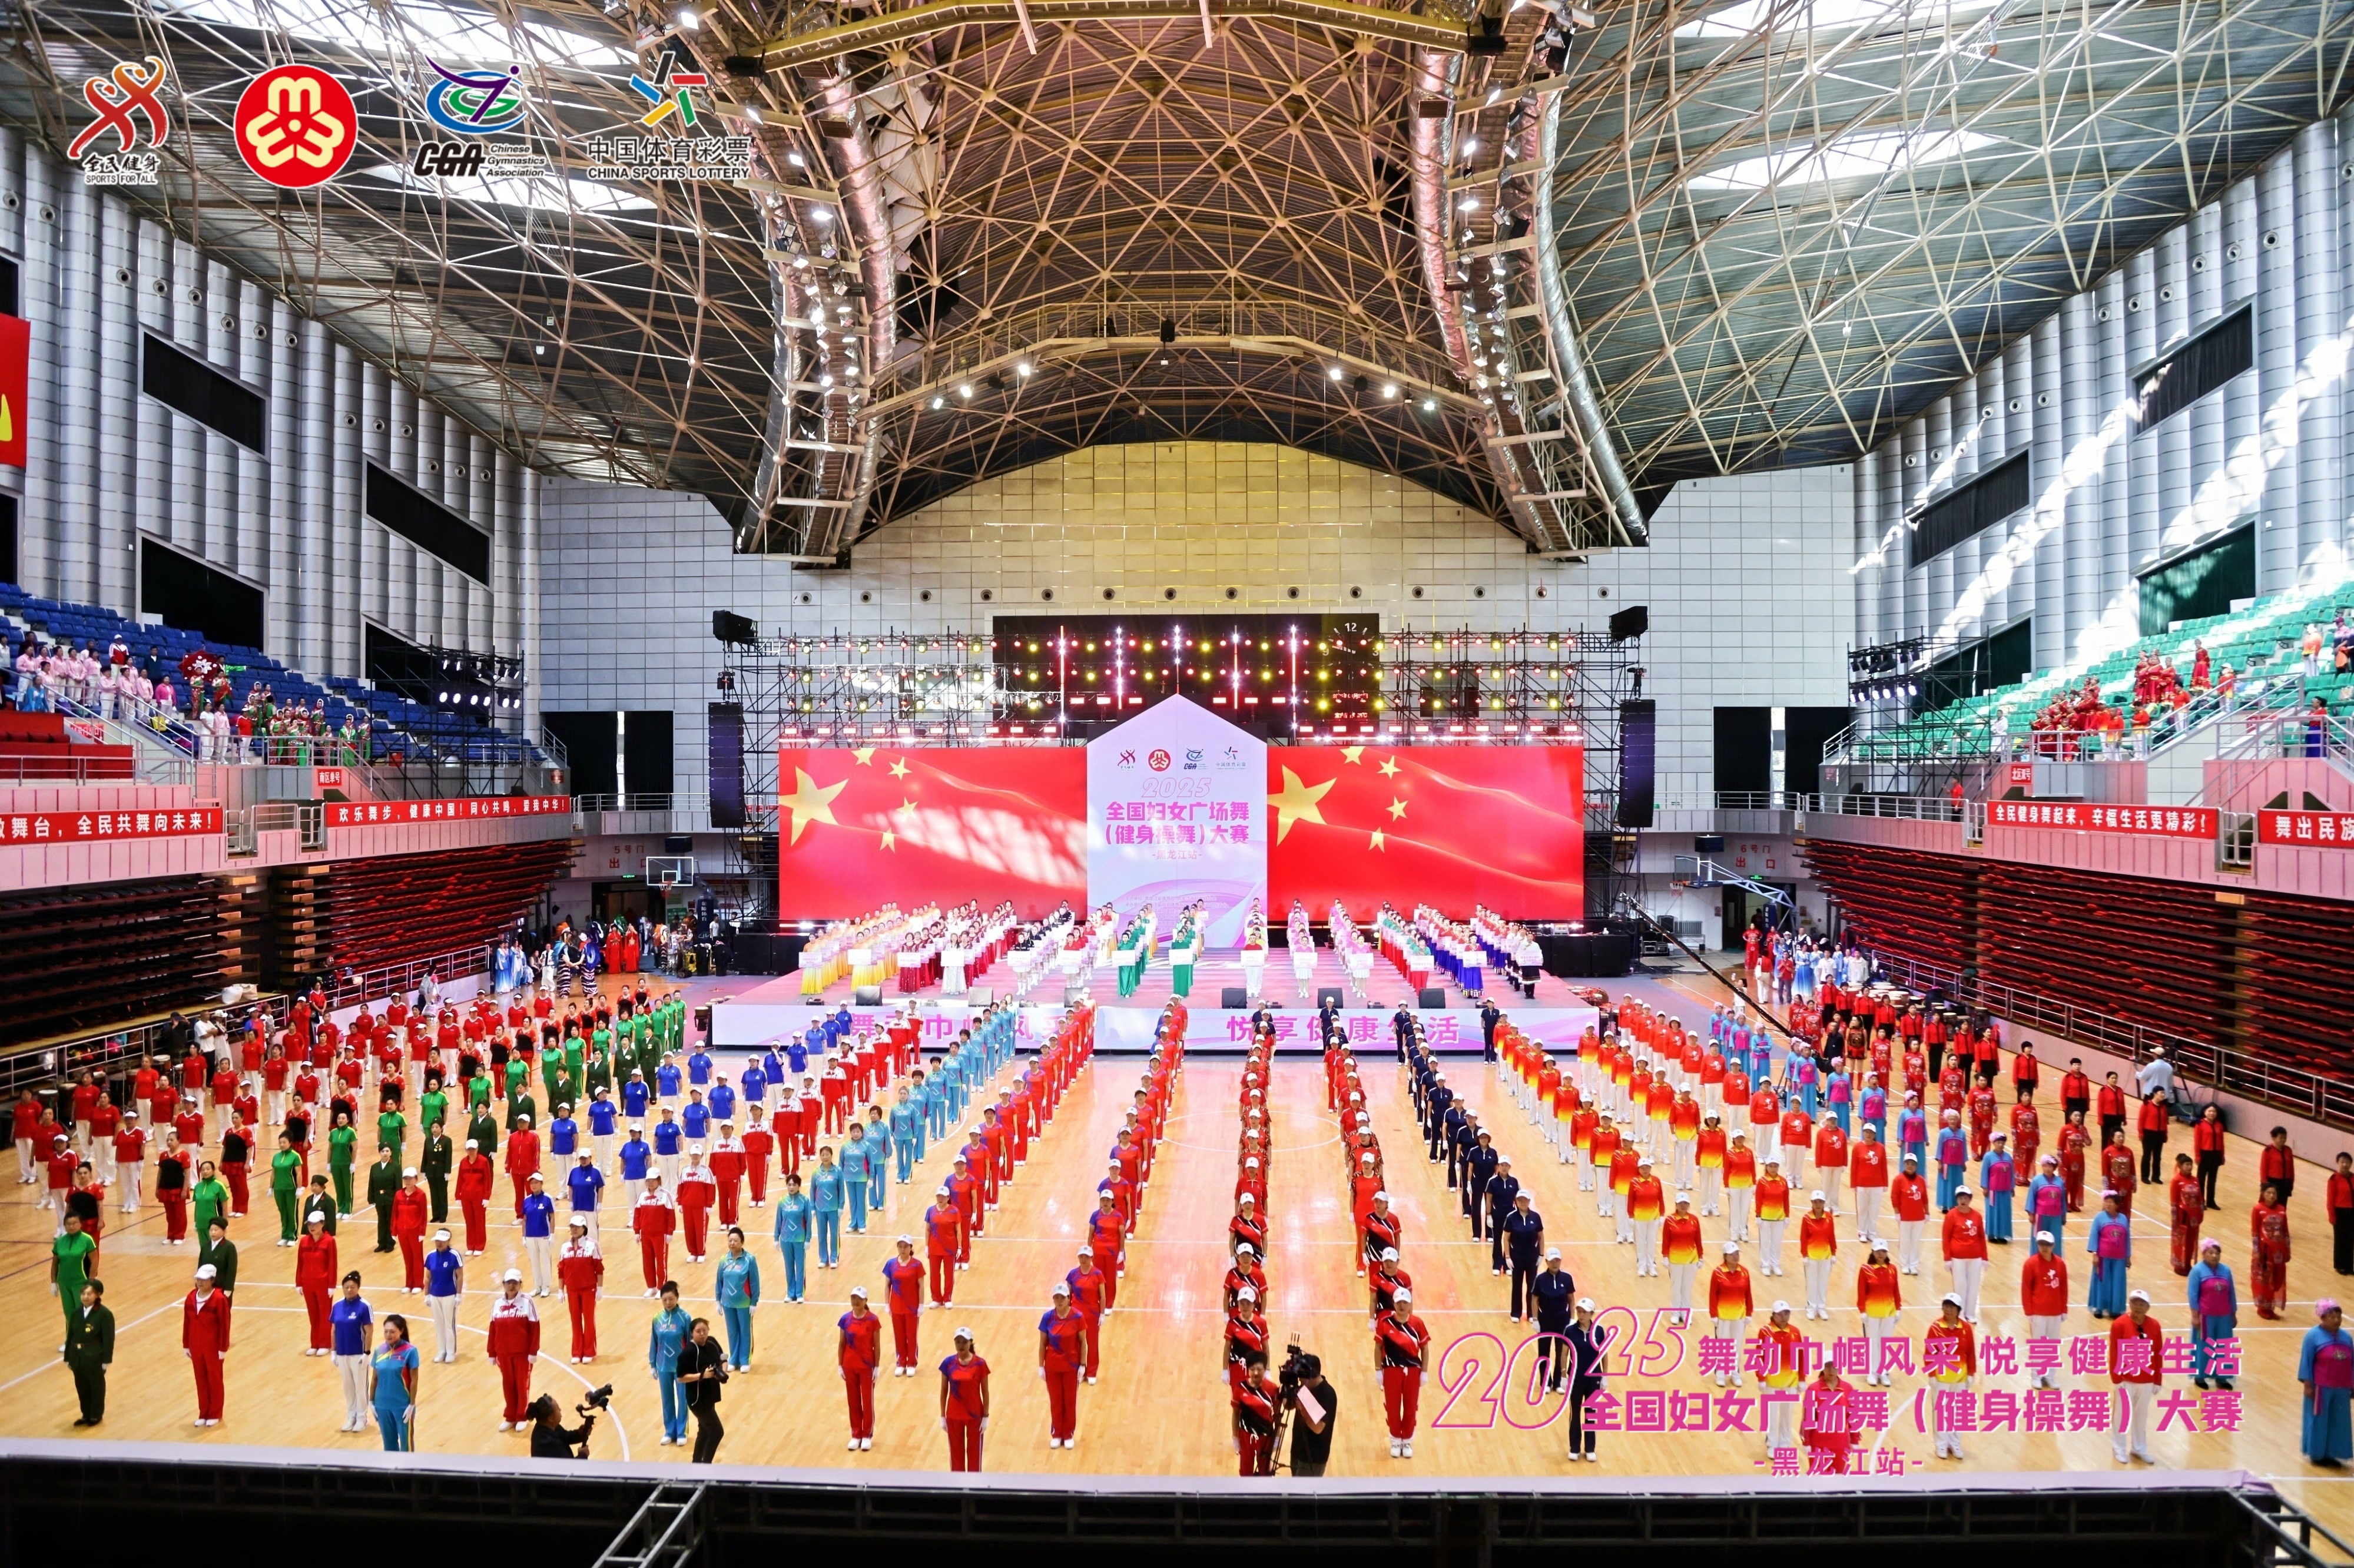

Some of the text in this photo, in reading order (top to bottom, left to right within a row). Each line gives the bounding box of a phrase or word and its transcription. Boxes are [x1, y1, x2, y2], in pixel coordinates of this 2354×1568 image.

[1344, 622, 1357, 632] 12
[319, 771, 340, 784] 南区单号
[1141, 777, 1212, 798] 2025
[1106, 801, 1249, 821] 全国妇女广场舞
[0, 812, 212, 839] 舞台，全民共舞向未来！
[2275, 816, 2354, 841] 舞出民族
[614, 844, 644, 854] 5号门
[1740, 844, 1771, 854] 6号门
[1735, 856, 1776, 869] 出口
[1226, 1015, 1461, 1043] 悦享健康活
